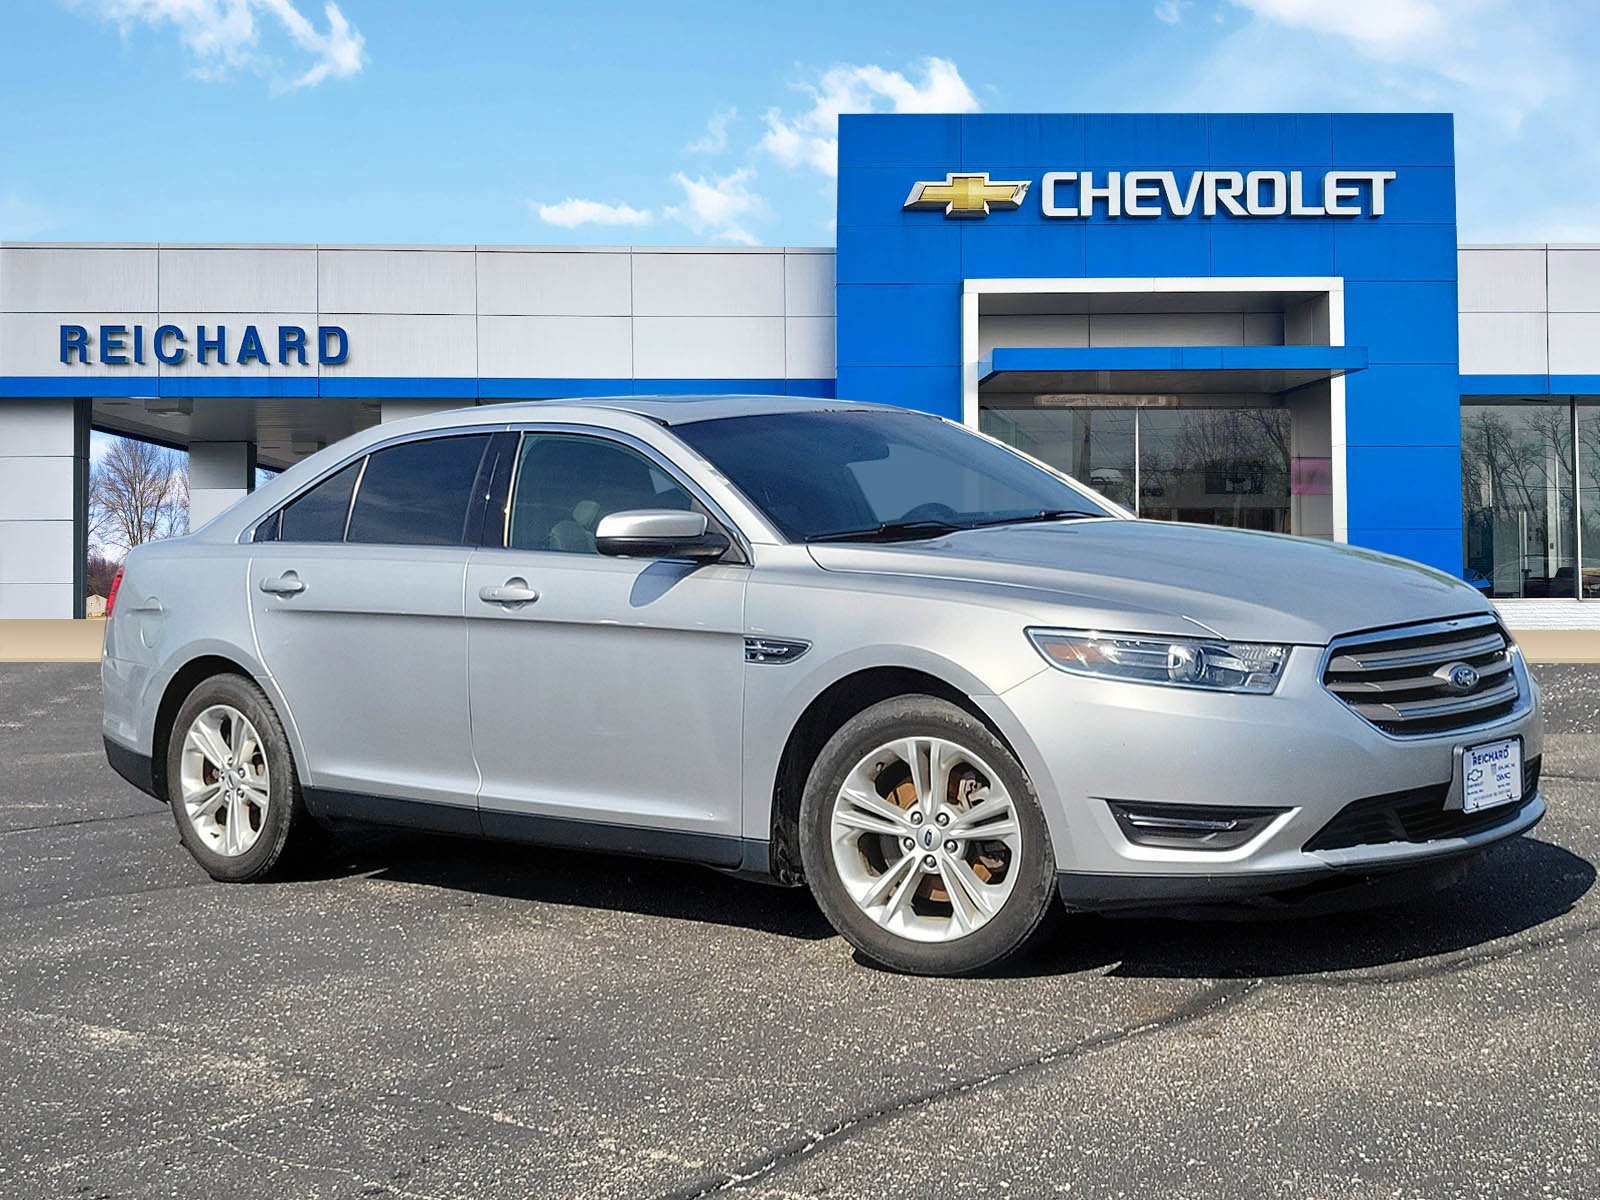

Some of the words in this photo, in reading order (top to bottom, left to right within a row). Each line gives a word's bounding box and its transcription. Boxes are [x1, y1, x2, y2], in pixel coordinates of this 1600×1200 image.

[1041, 170, 1397, 218] CHEVROLET
[60, 325, 349, 365] REICHARD
[1472, 749, 1509, 766] REICHARD
